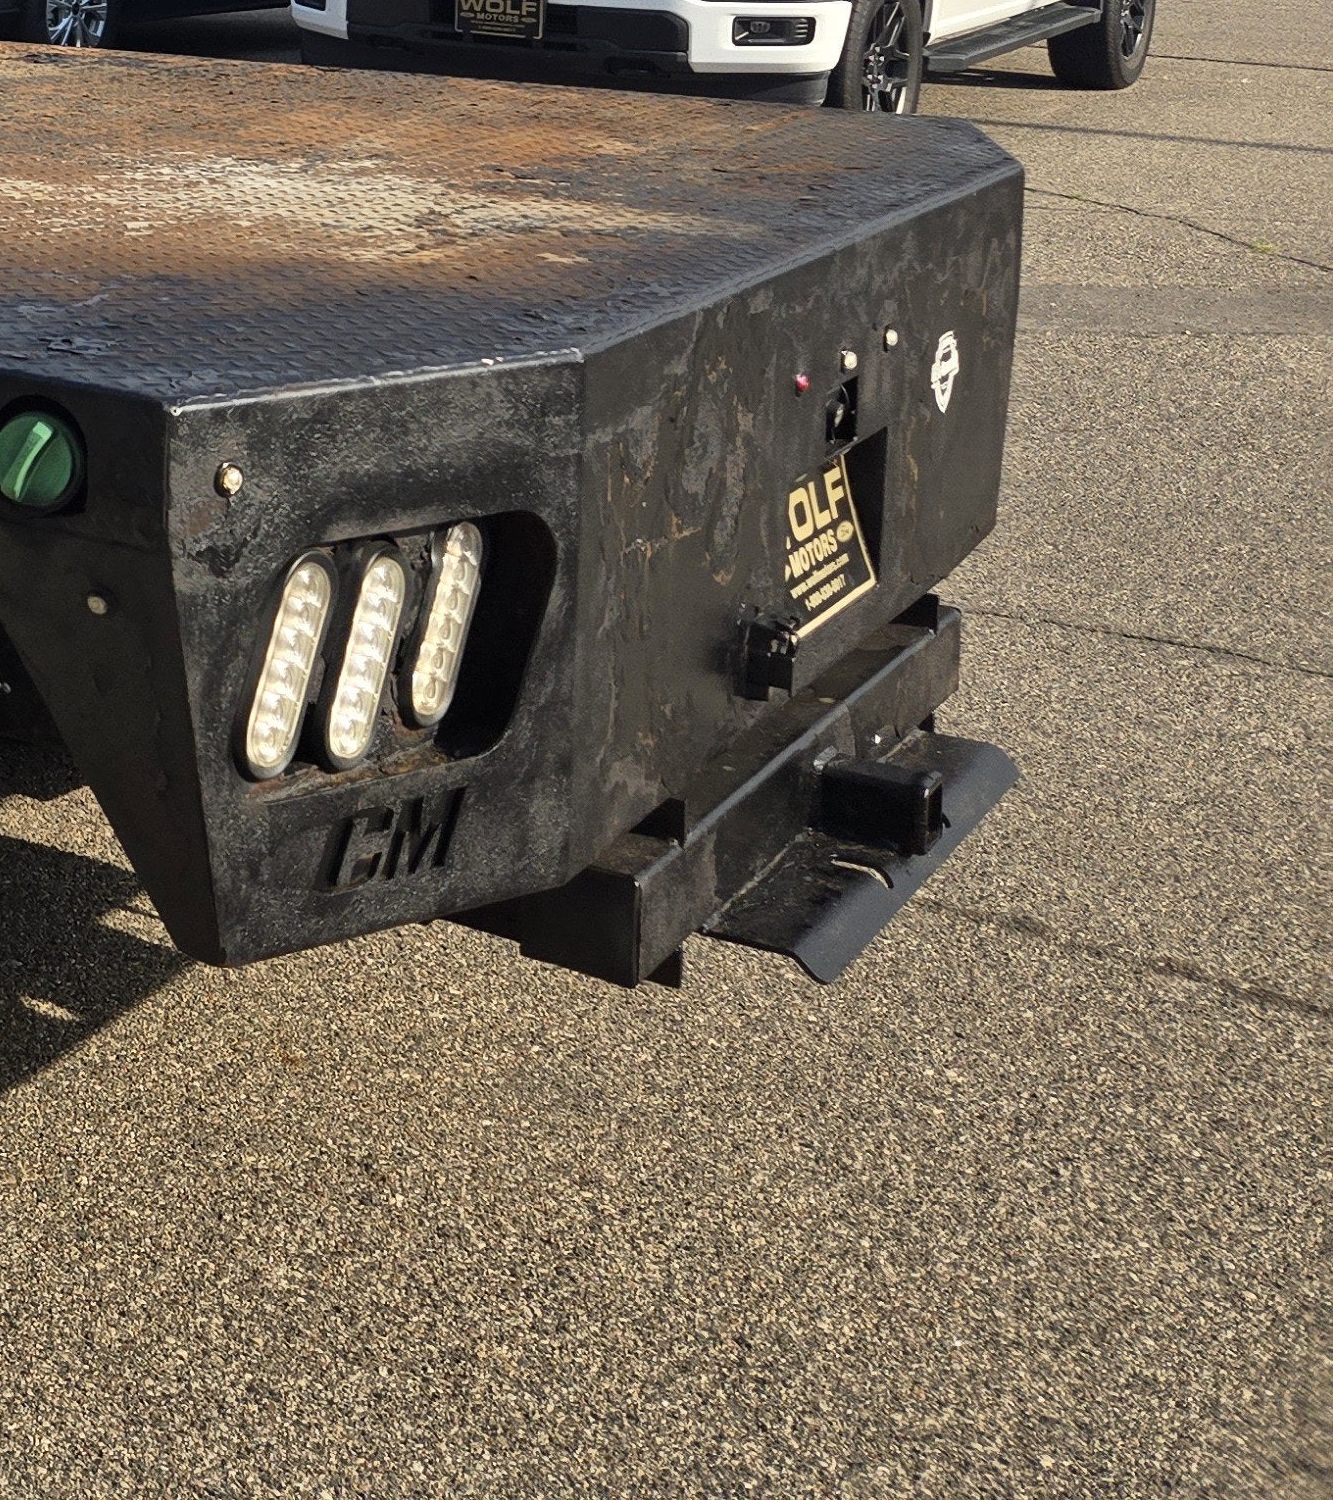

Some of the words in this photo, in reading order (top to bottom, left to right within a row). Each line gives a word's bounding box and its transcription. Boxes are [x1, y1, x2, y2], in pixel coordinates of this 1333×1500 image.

[476, 12, 519, 23] MOTORS
[786, 467, 845, 549] OLF
[788, 529, 838, 578] MOTORS
